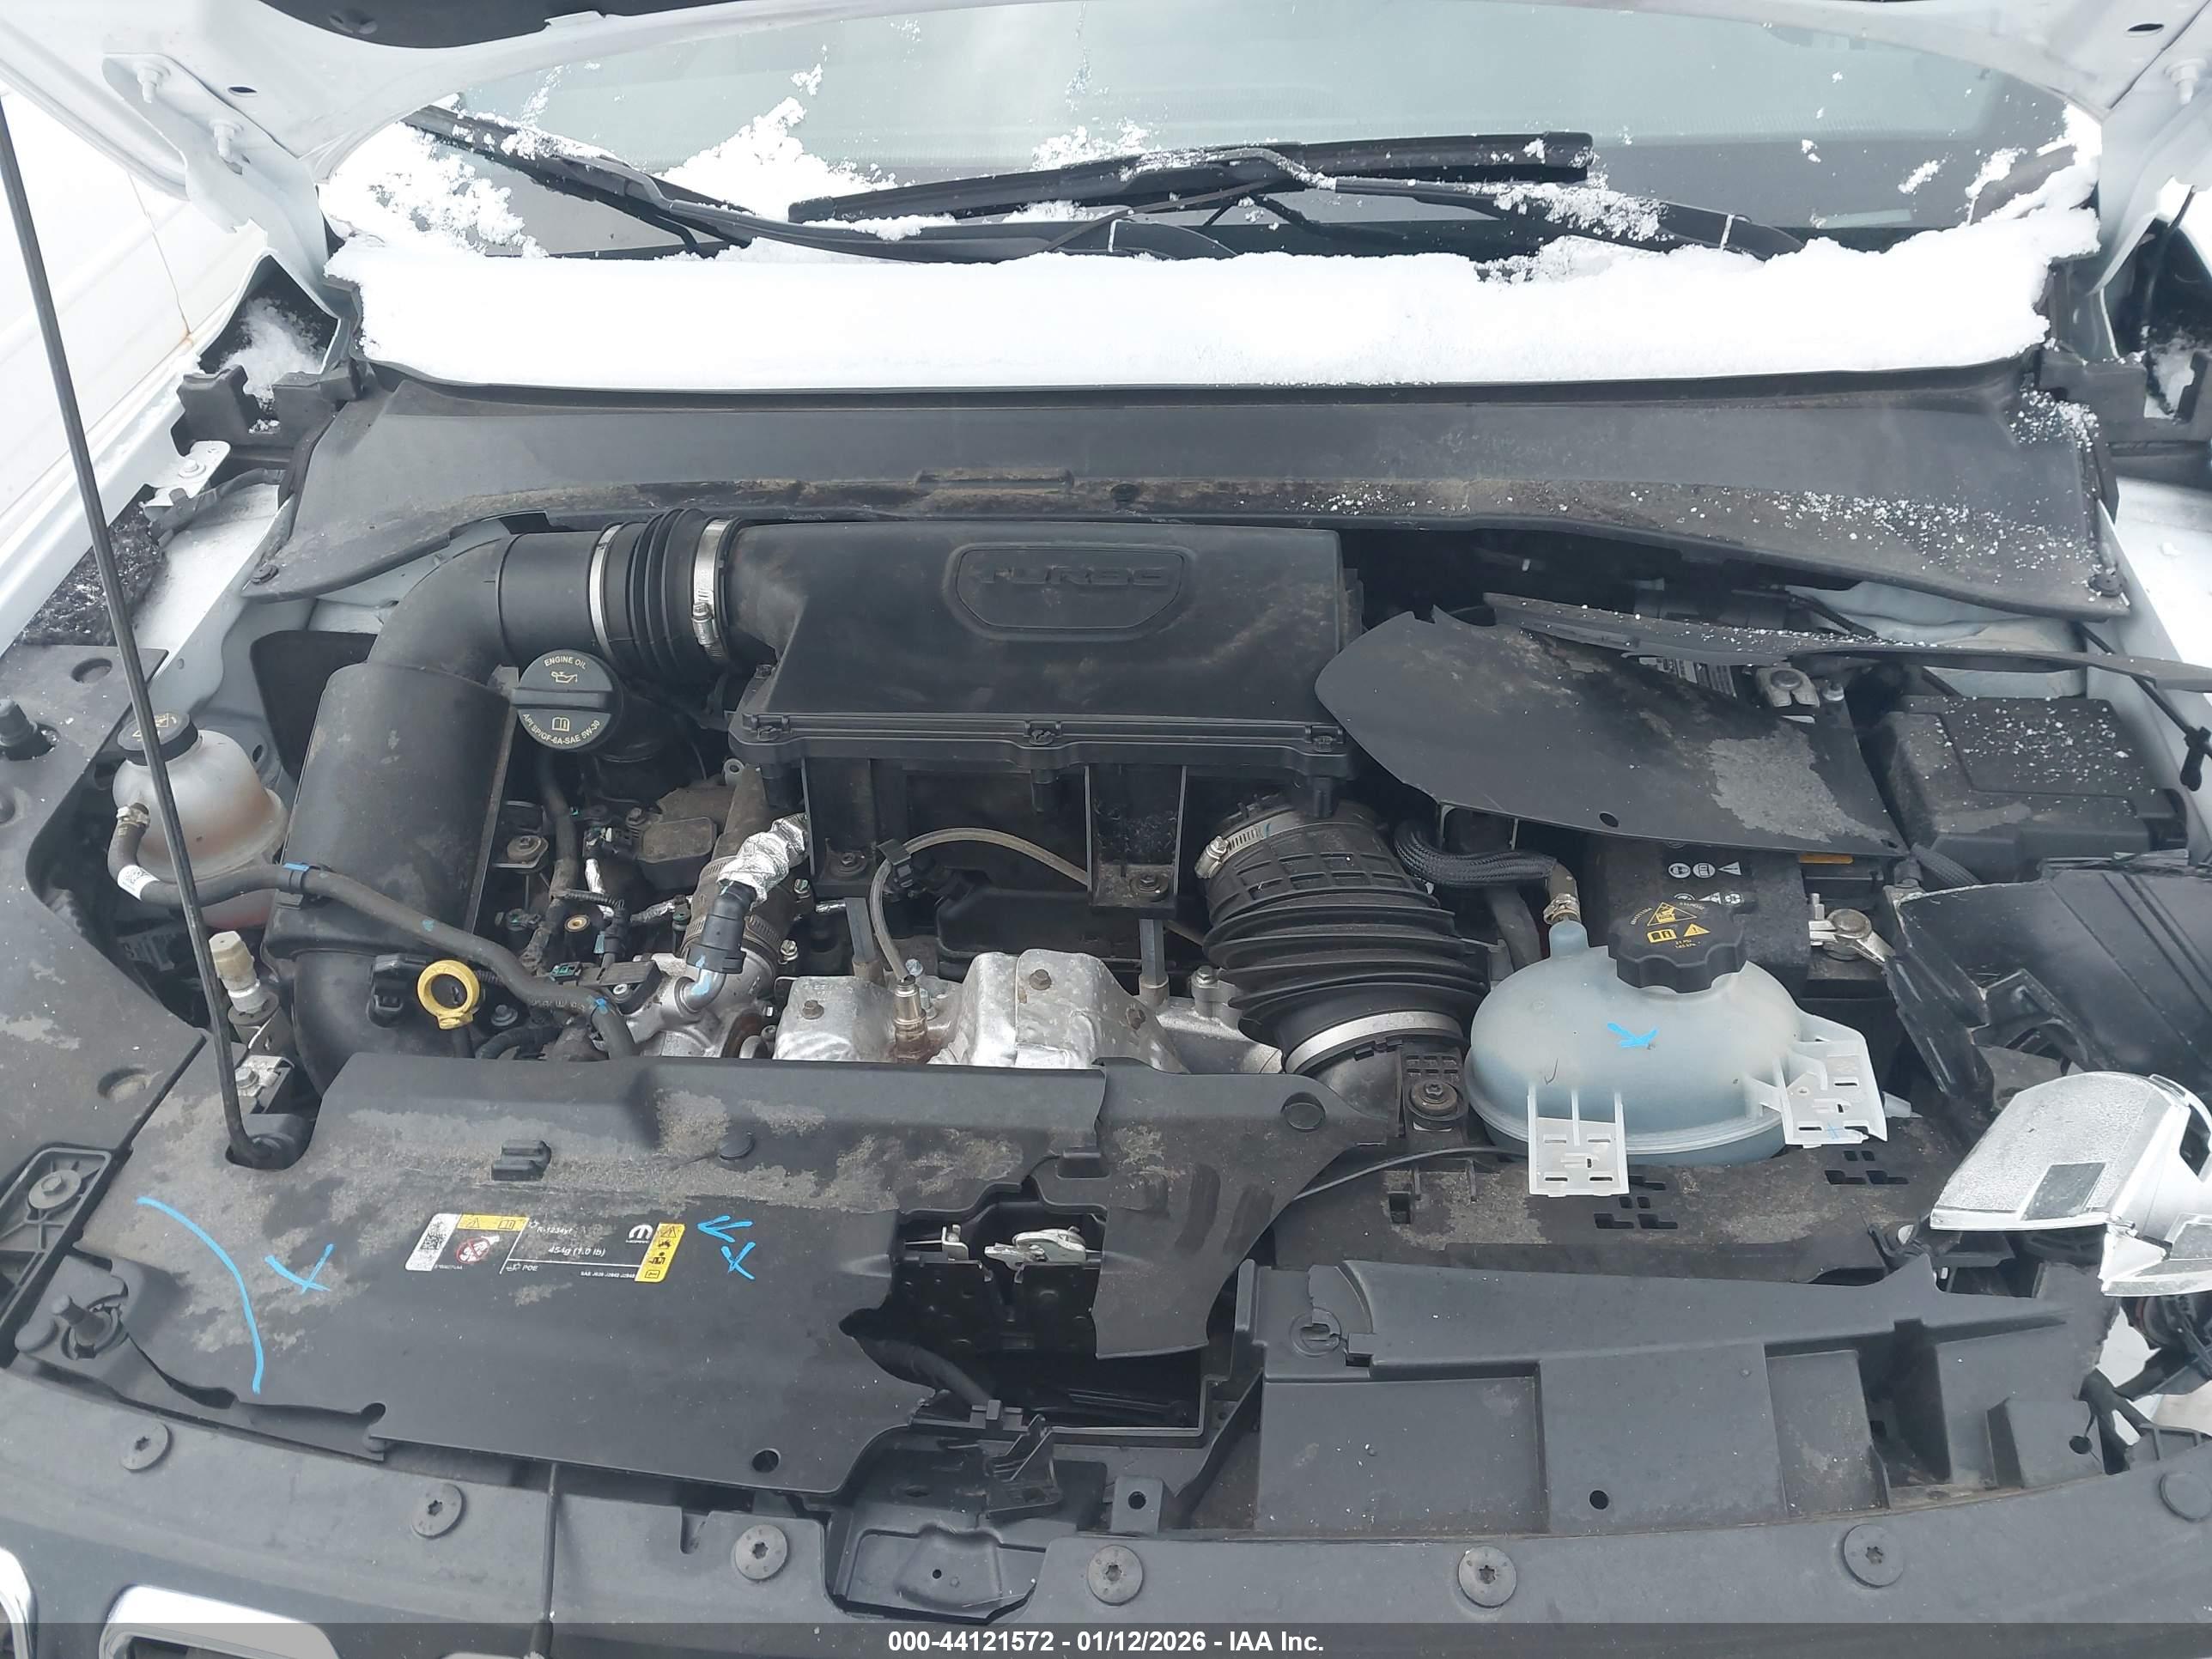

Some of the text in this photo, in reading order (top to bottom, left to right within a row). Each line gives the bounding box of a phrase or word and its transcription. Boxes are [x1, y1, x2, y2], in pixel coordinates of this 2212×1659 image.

[544, 656, 586, 670] ENGINE OIL
[523, 714, 532, 726] API
[581, 720, 600, 738] 5W-30
[548, 1245, 606, 1257] 454g (1.0 lb)
